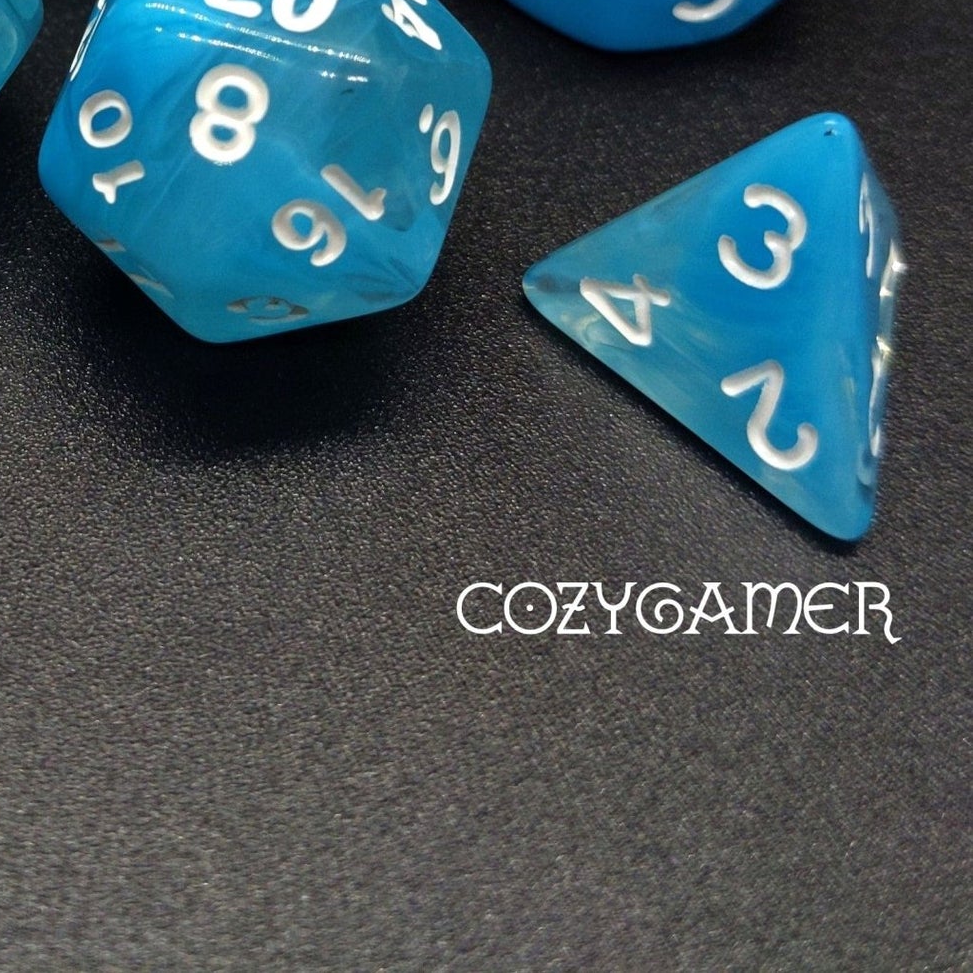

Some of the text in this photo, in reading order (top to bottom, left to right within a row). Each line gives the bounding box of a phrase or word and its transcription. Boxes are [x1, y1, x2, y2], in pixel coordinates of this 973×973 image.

[78, 89, 146, 205] 10
[188, 63, 270, 165] 8
[717, 183, 807, 290] 3
[579, 273, 671, 347] 4
[720, 359, 819, 471] 2
